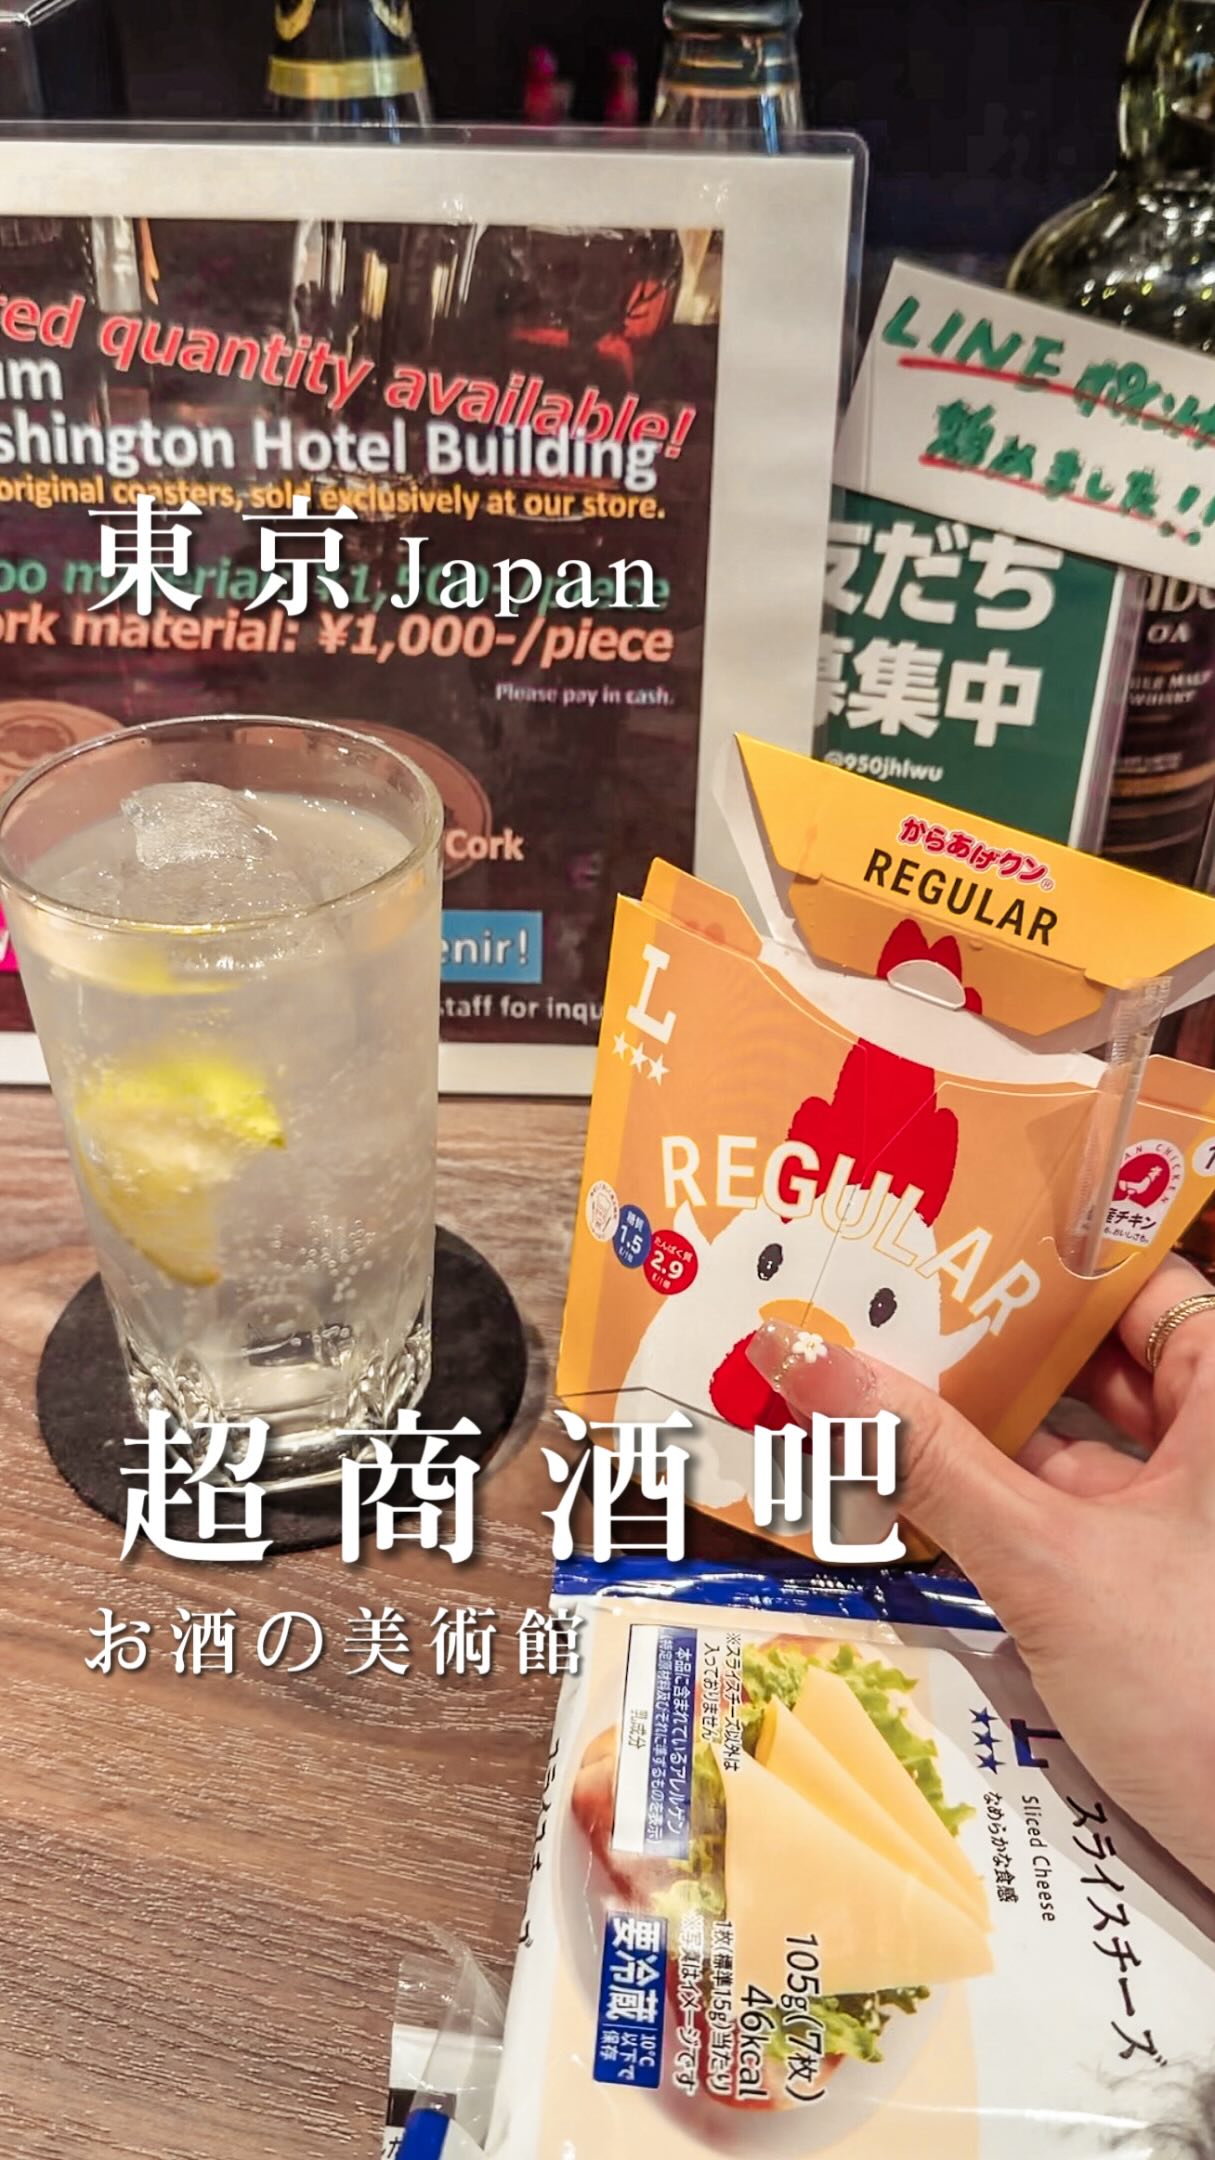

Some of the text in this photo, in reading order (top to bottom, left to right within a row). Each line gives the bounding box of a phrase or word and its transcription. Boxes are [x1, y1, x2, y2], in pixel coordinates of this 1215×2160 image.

[0, 295, 697, 459] ed quantity available!
[0, 357, 63, 401] m
[881, 295, 1065, 385] LINE
[0, 474, 667, 520] original coasters, sold exclusively at our store.
[254, 415, 407, 475] Hotel
[427, 418, 658, 492] Building
[71, 608, 299, 653] material:
[318, 612, 675, 669] ¥1,000-/piece
[495, 683, 675, 709] Please pay in cash.
[445, 829, 524, 861] Cork
[863, 848, 1058, 946] REGULAR
[500, 995, 540, 1019] for
[626, 944, 677, 1044] L
[620, 1225, 643, 1255] 1.5
[650, 1250, 684, 1280] 2.9
[660, 1134, 1041, 1336] REGULAR
[701, 1642, 720, 1742] 入っておりません
[667, 1647, 693, 1835] 本品に含まれているアレルゲン
[983, 1791, 1018, 1904] なめらかな食感
[1022, 1795, 1056, 1923] Sliced Cheese
[605, 1917, 661, 2024] 要冷蔵
[1065, 1796, 1168, 2068] スライスチーズ
[600, 2030, 619, 2061] 保存
[617, 2032, 638, 2081] 以下で
[738, 1984, 775, 2099] 46kcal
[780, 1933, 826, 2101] 105g(7枚)
